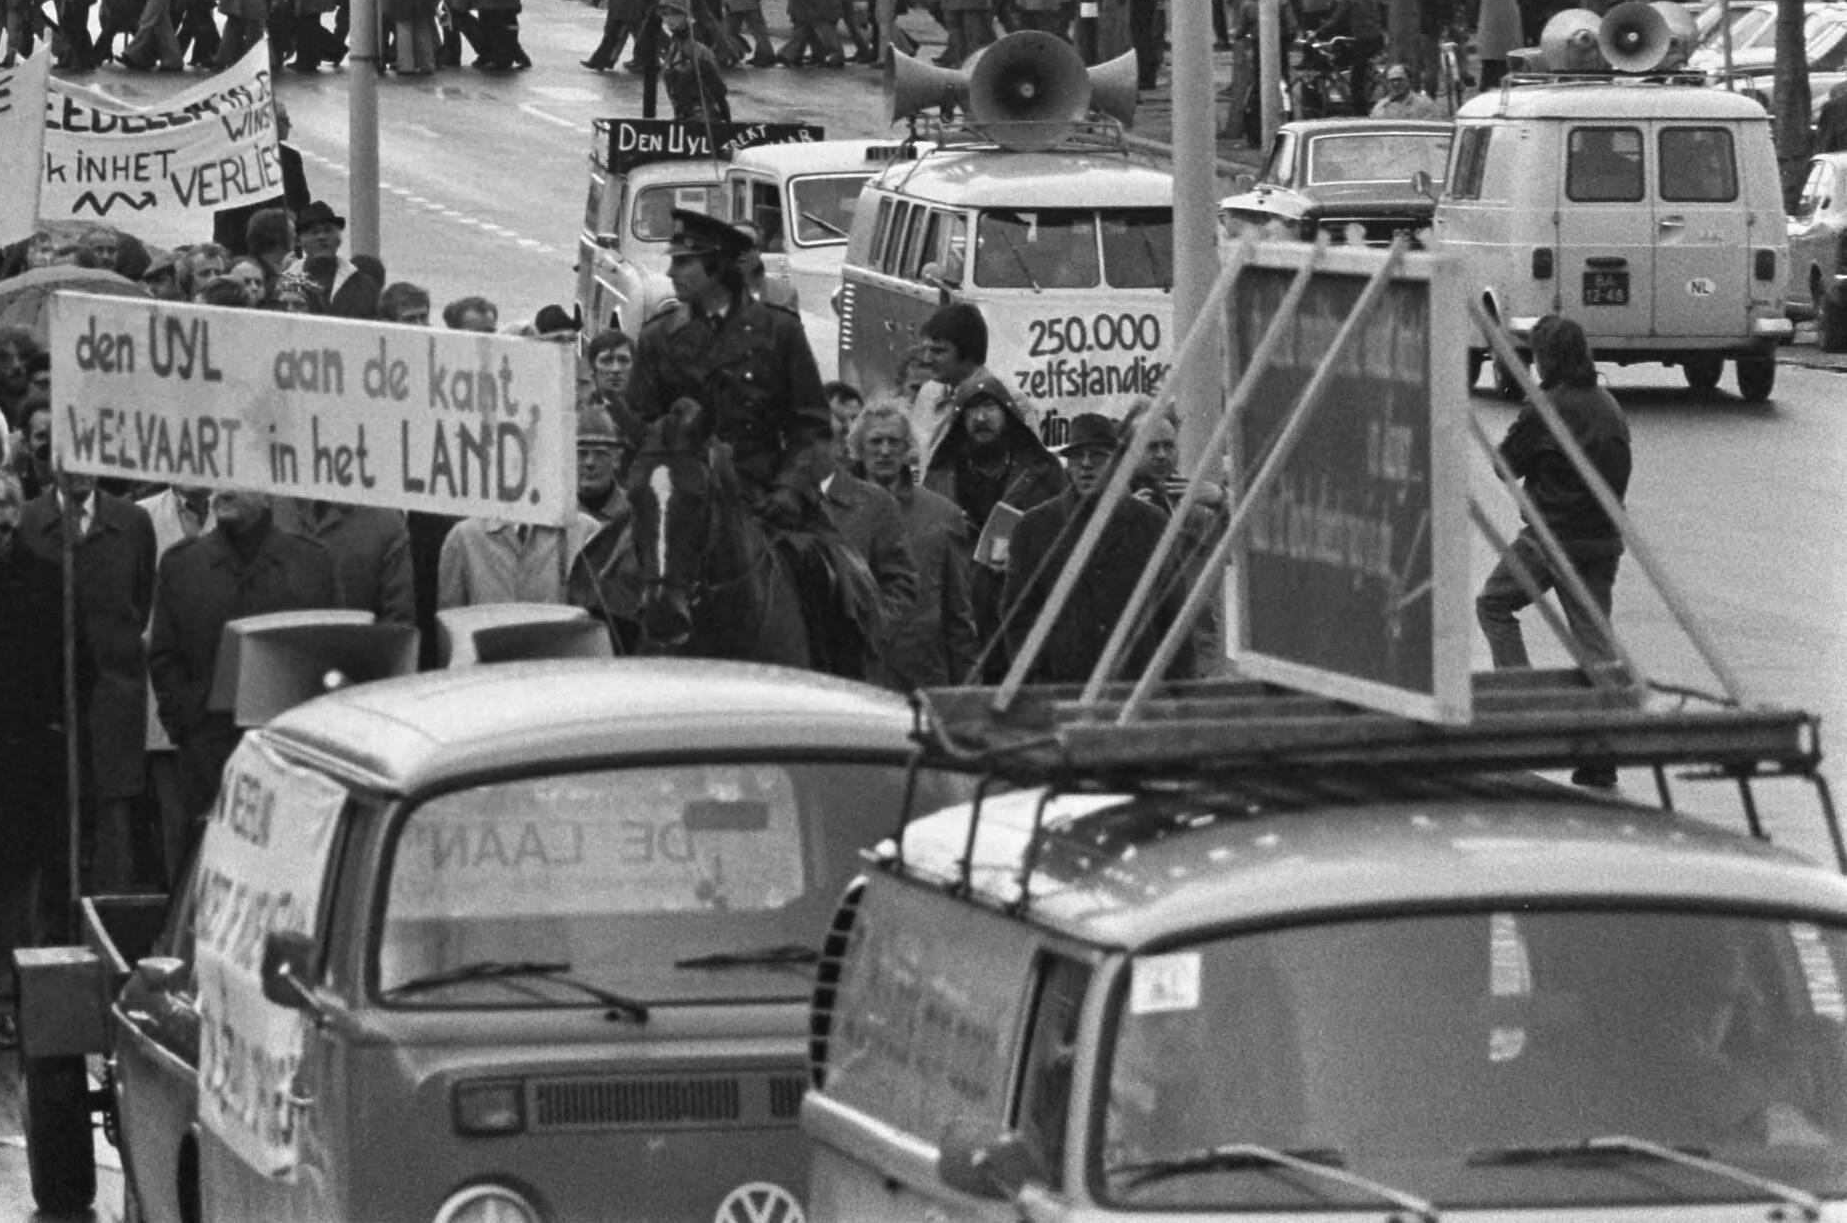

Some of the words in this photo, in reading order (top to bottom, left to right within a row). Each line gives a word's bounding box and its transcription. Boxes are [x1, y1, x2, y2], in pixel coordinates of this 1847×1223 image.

[1691, 280, 1711, 295] NL
[75, 316, 136, 374] den
[273, 346, 344, 396] aan
[362, 335, 410, 401] de
[1029, 313, 1161, 357] 250.000
[67, 403, 242, 478] WELVAART
[268, 423, 298, 484] in
[312, 414, 376, 489] het
[400, 418, 542, 505] LAND.
